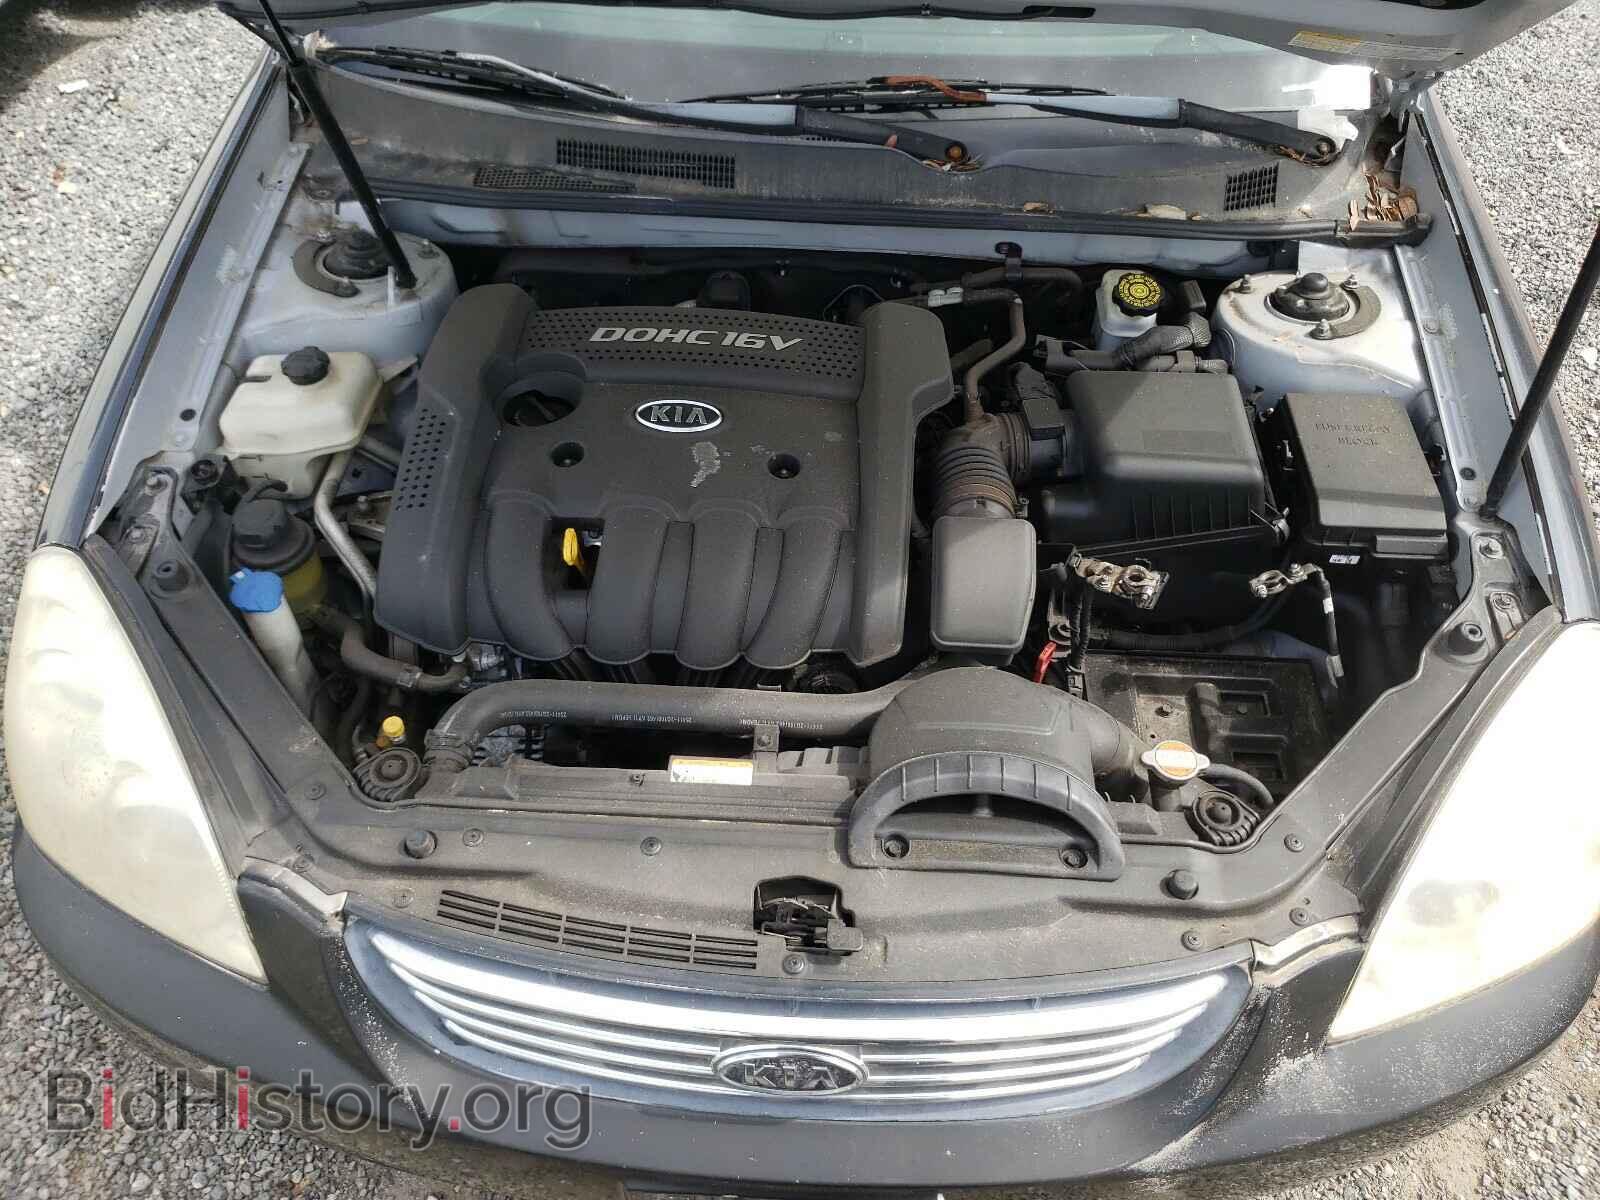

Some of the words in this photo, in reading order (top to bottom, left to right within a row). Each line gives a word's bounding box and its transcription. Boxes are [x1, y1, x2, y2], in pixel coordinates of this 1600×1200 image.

[589, 327, 719, 345] DOHC
[721, 331, 804, 351] 16V
[650, 405, 708, 425] KIA
[742, 1062, 839, 1089] KIA
